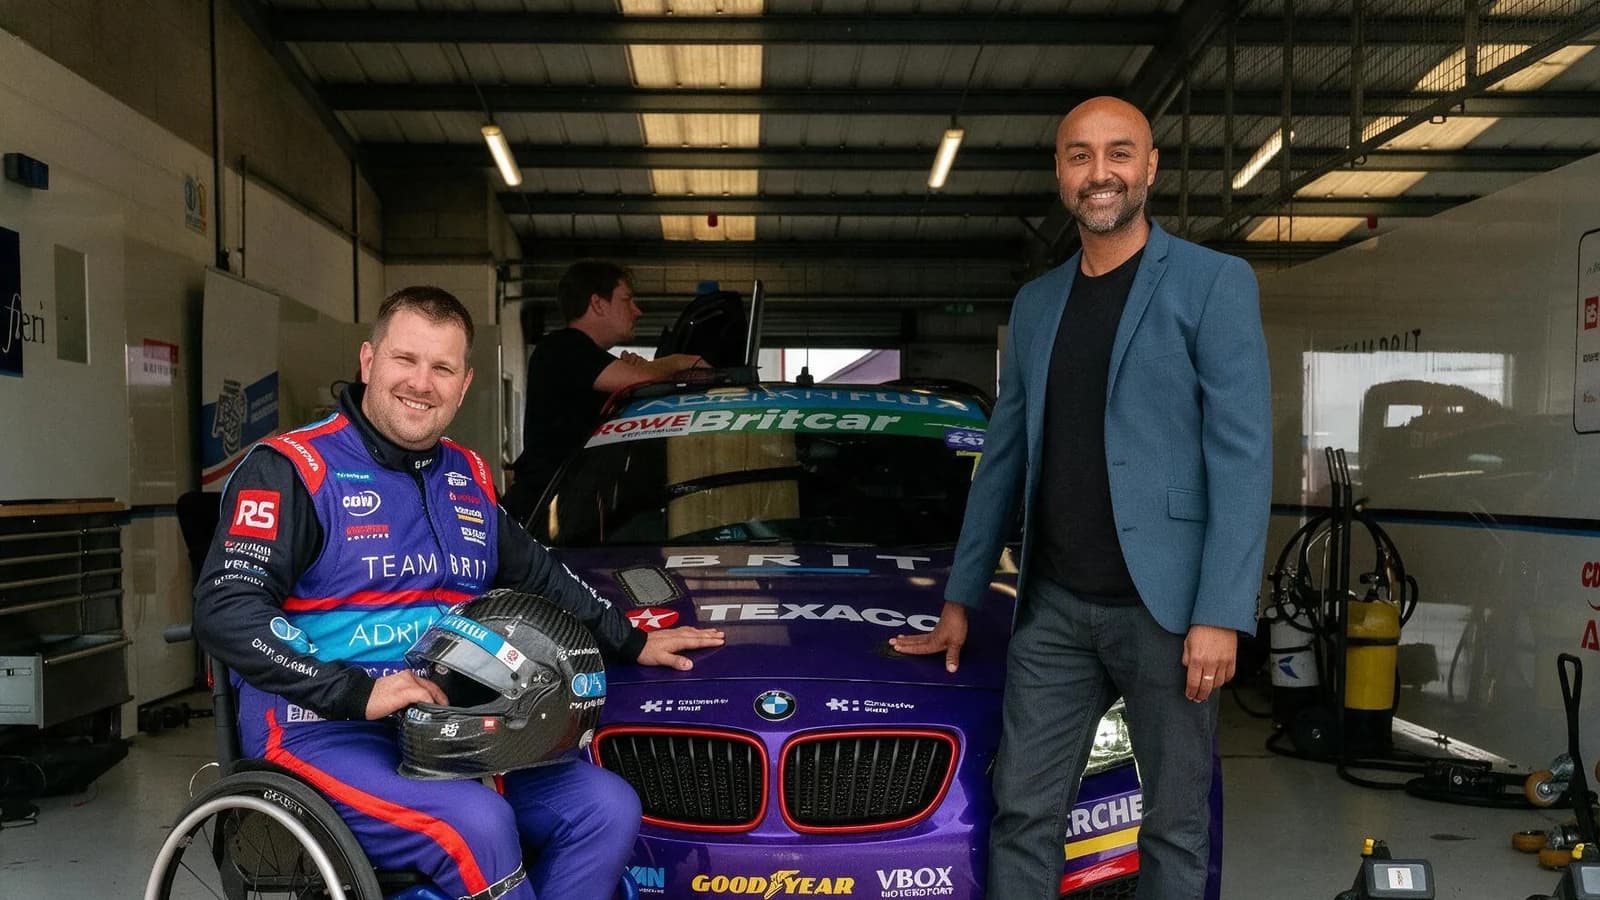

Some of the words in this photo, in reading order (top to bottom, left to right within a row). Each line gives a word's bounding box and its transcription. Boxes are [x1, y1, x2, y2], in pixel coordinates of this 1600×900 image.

[592, 414, 691, 437] ROWE
[692, 408, 901, 433] Britcar
[235, 499, 275, 529] RS
[361, 553, 437, 580] TEAM
[665, 553, 931, 570] BRIT
[700, 603, 940, 632] TEXACO
[348, 616, 433, 647] ADRI
[1066, 794, 1144, 838] RCHE
[876, 866, 953, 890] VBOX
